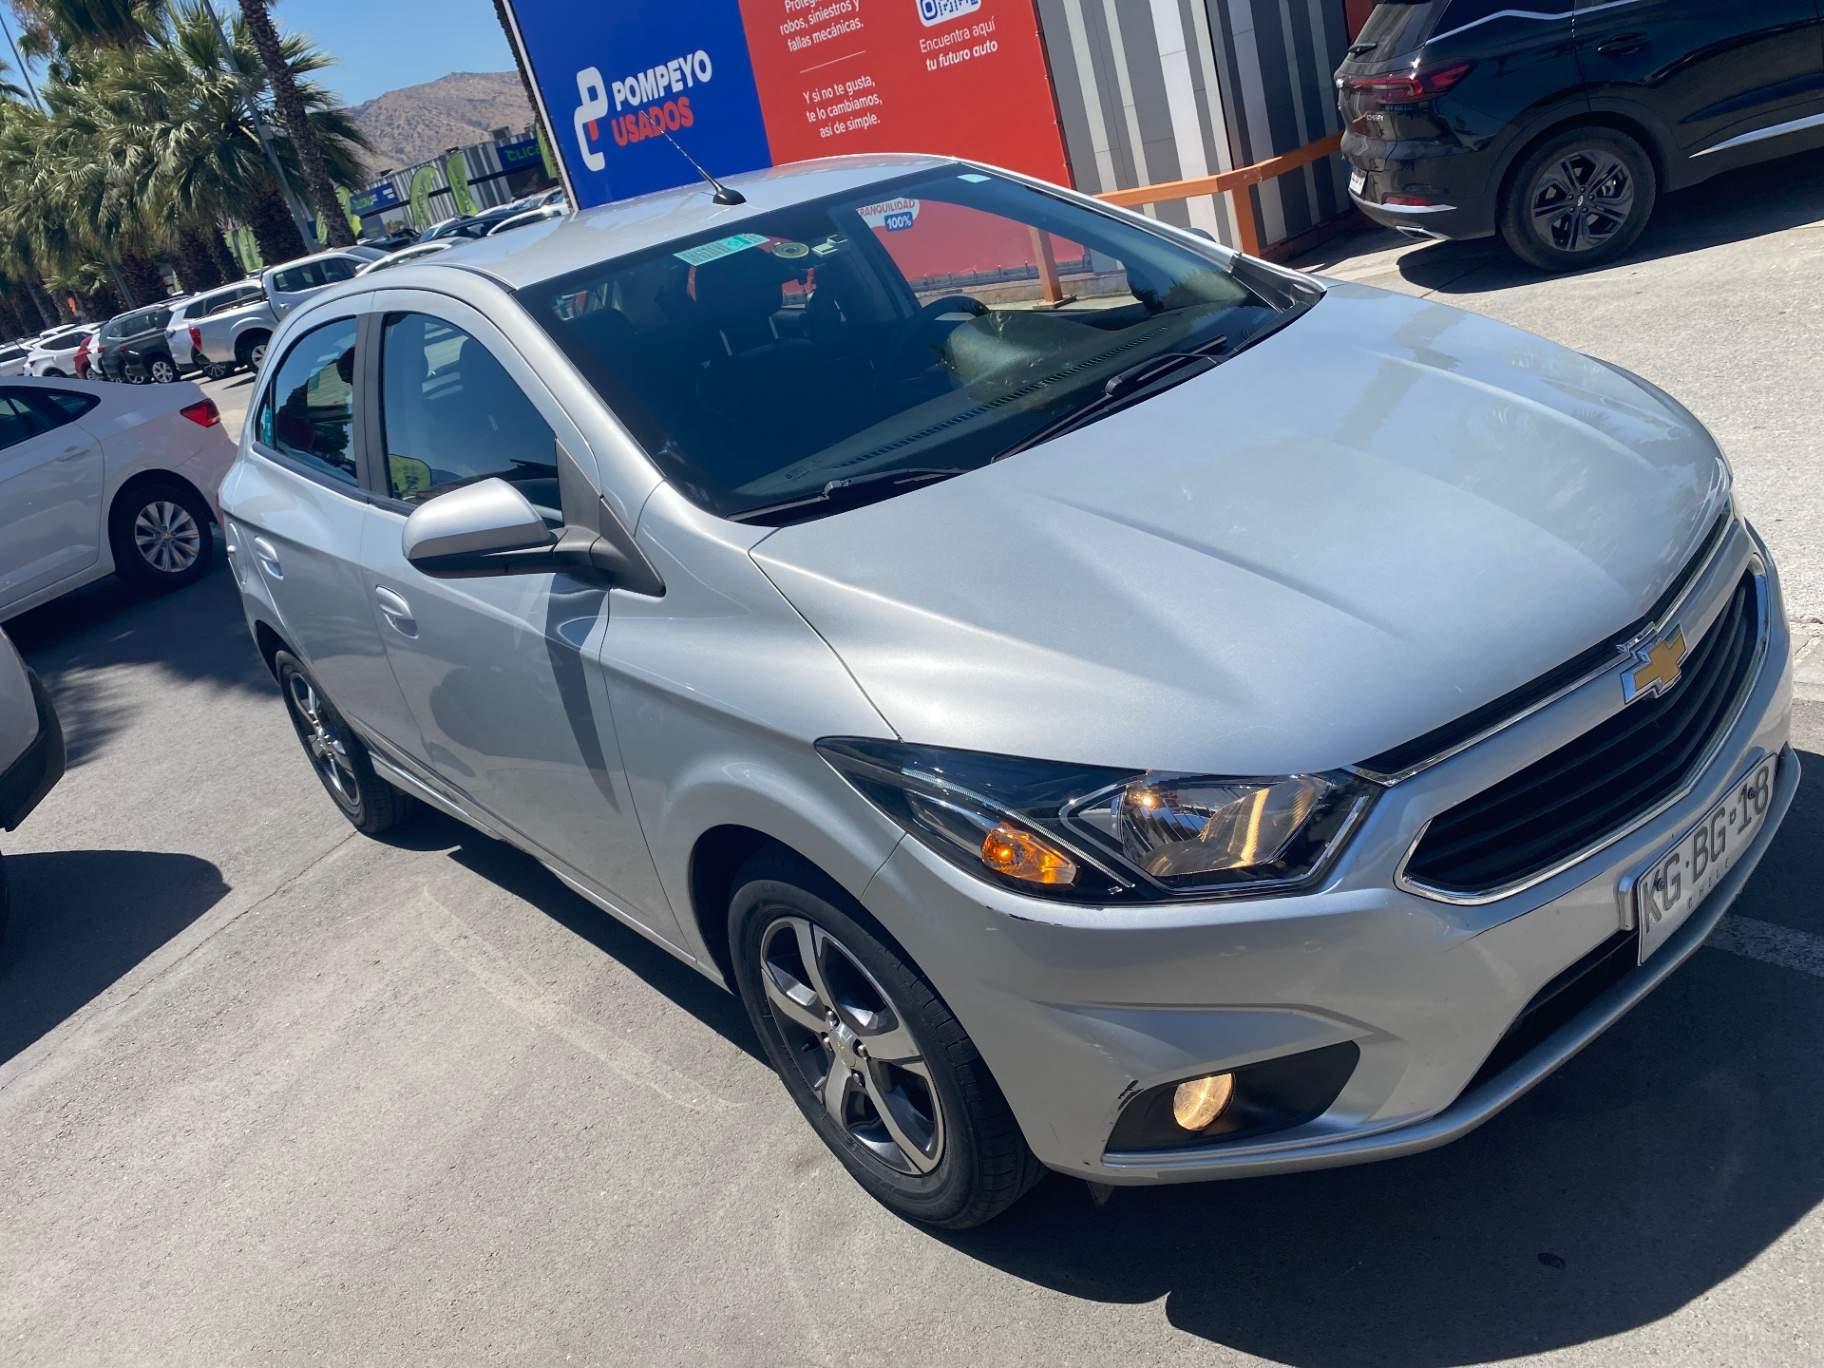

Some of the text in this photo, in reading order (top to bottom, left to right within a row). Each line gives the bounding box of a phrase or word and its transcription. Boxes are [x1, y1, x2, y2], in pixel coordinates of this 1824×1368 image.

[780, 0, 860, 35] robos, siniestros y
[788, 18, 864, 52] fallas mecánicas.
[919, 16, 996, 53] Encuentra aquí
[926, 40, 998, 71] tu futuro auto
[612, 50, 712, 111] POMPEYO
[802, 75, 876, 104] Y si no te gusta,
[611, 97, 694, 146] USADOS
[806, 93, 883, 122] te lo cambiamos,
[833, 120, 846, 134] de
[846, 112, 881, 130] simple.
[887, 214, 912, 230] 100%
